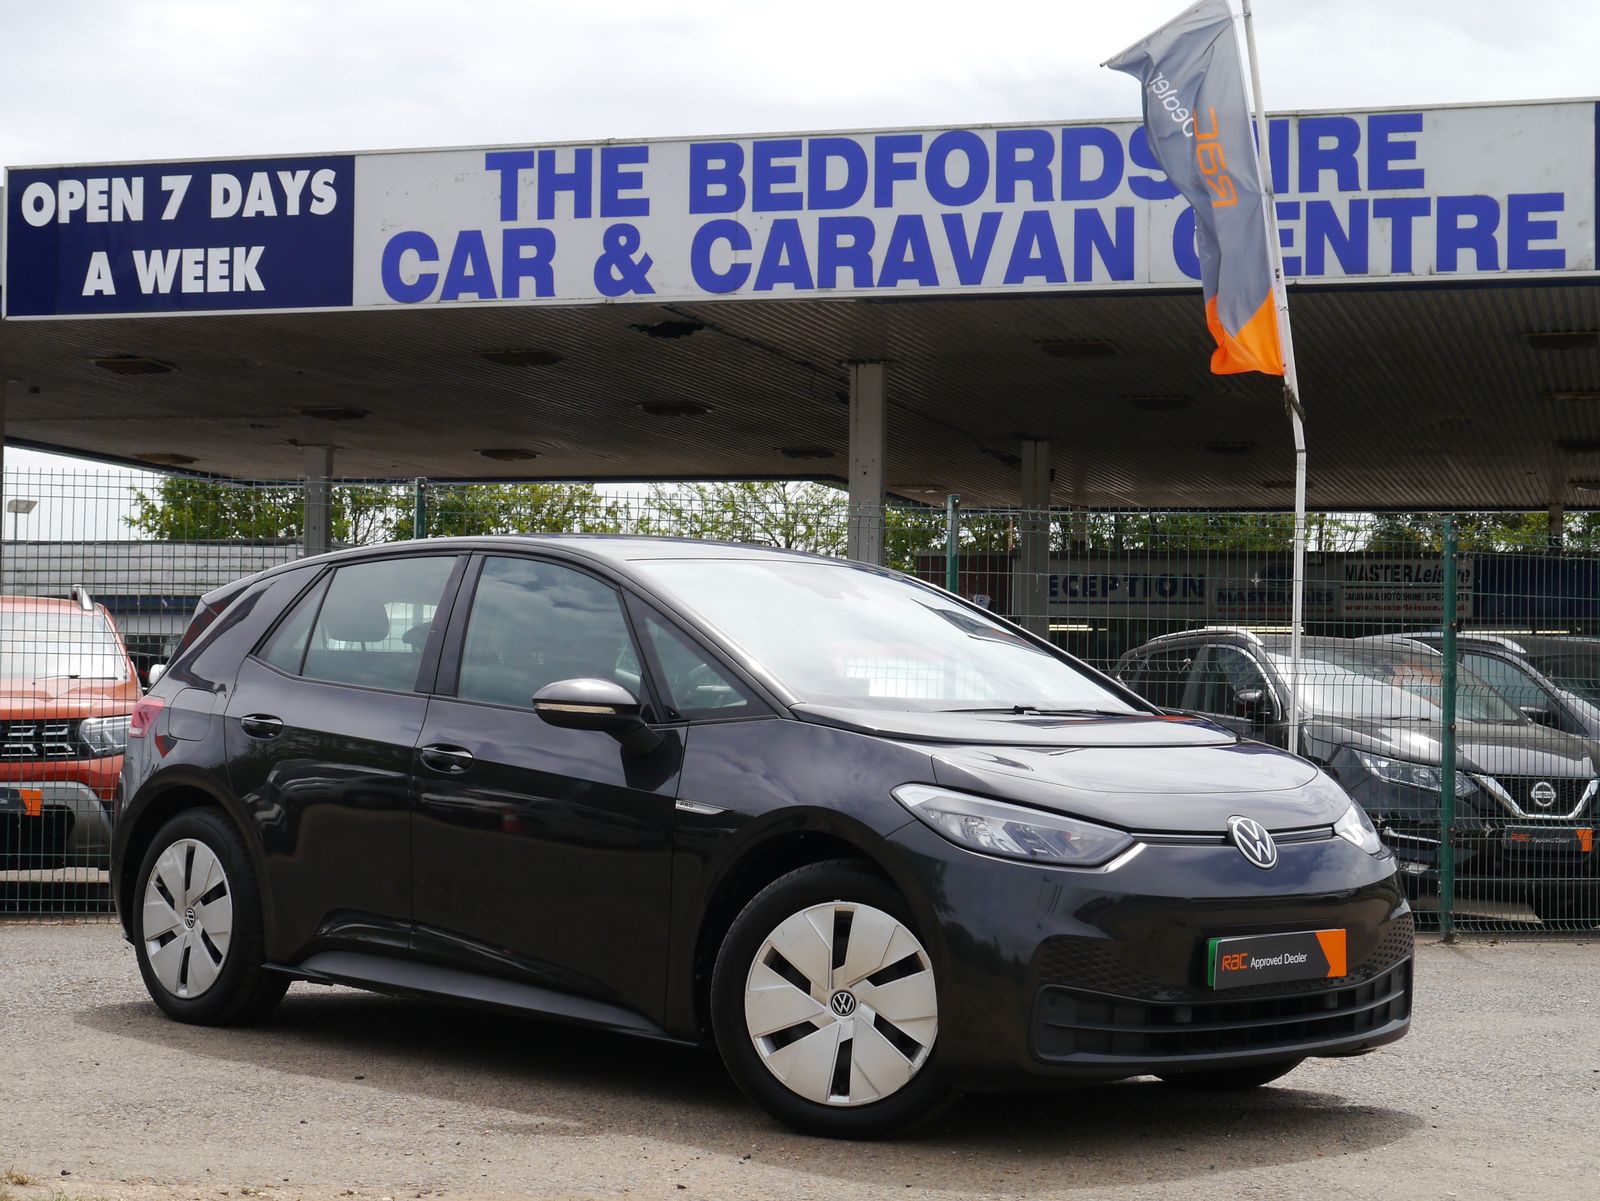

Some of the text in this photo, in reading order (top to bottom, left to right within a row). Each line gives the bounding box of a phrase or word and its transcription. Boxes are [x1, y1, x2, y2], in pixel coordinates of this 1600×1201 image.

[485, 113, 1425, 221] THE BEDFORDSIRE
[21, 168, 337, 227] OPEN 7 DAYS
[82, 246, 266, 296] A WEEK
[381, 228, 556, 303] CAR
[594, 223, 655, 297] &
[690, 207, 1135, 293] CARAVAN
[1049, 573, 1205, 598] ECEPTION
[1250, 954, 1283, 970] Approved
[1284, 953, 1308, 964] Dealer
